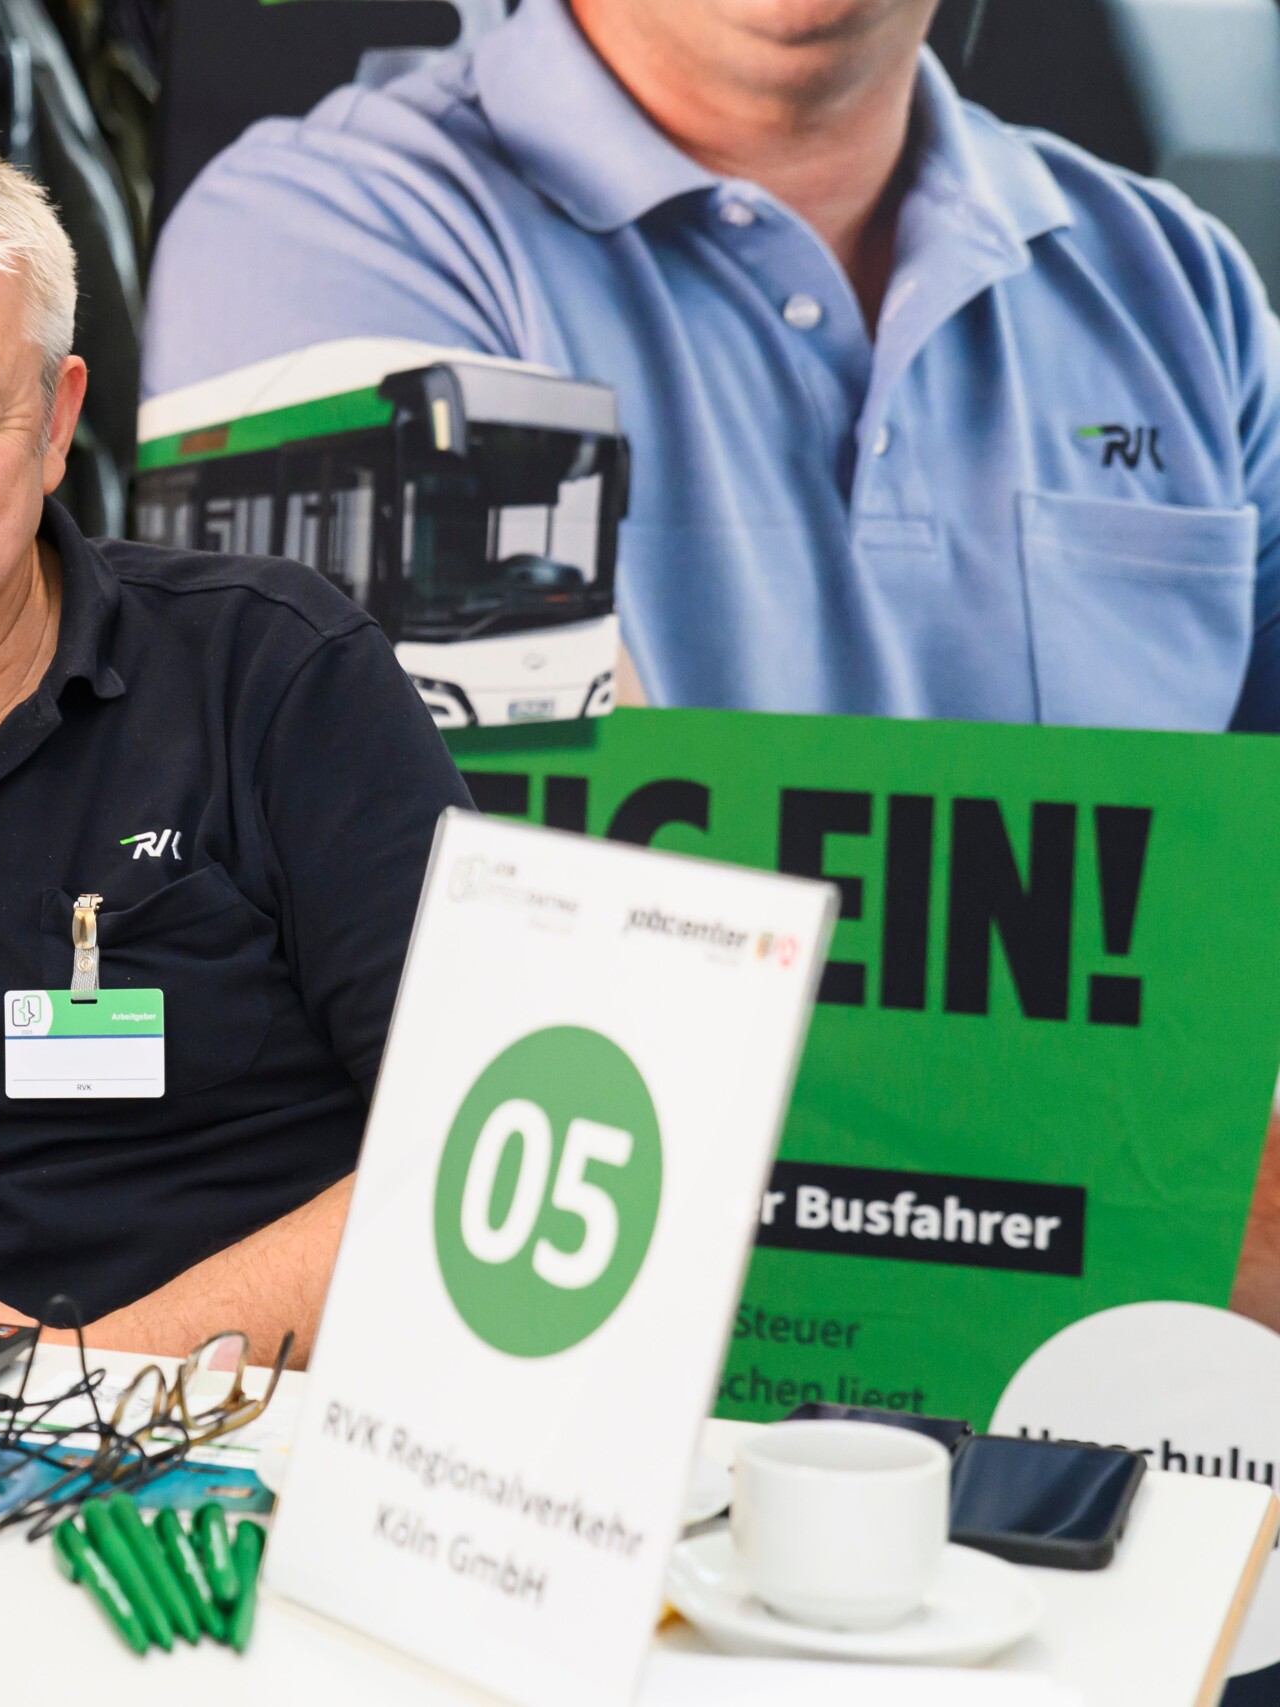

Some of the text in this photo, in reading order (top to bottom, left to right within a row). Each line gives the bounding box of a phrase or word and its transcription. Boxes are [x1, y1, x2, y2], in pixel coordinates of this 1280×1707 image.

[623, 906, 748, 949] jobcenter
[777, 787, 1154, 1028] EIN!
[111, 1012, 157, 1022] Arbeitgeber
[76, 1083, 92, 1091] RVK
[460, 1097, 635, 1291] 05
[796, 1184, 1061, 1251] Busfahrer
[733, 1304, 861, 1348] Steuer
[322, 1398, 645, 1558] RVK Regionalverkehr
[374, 1503, 549, 1603] Köln GmbH
